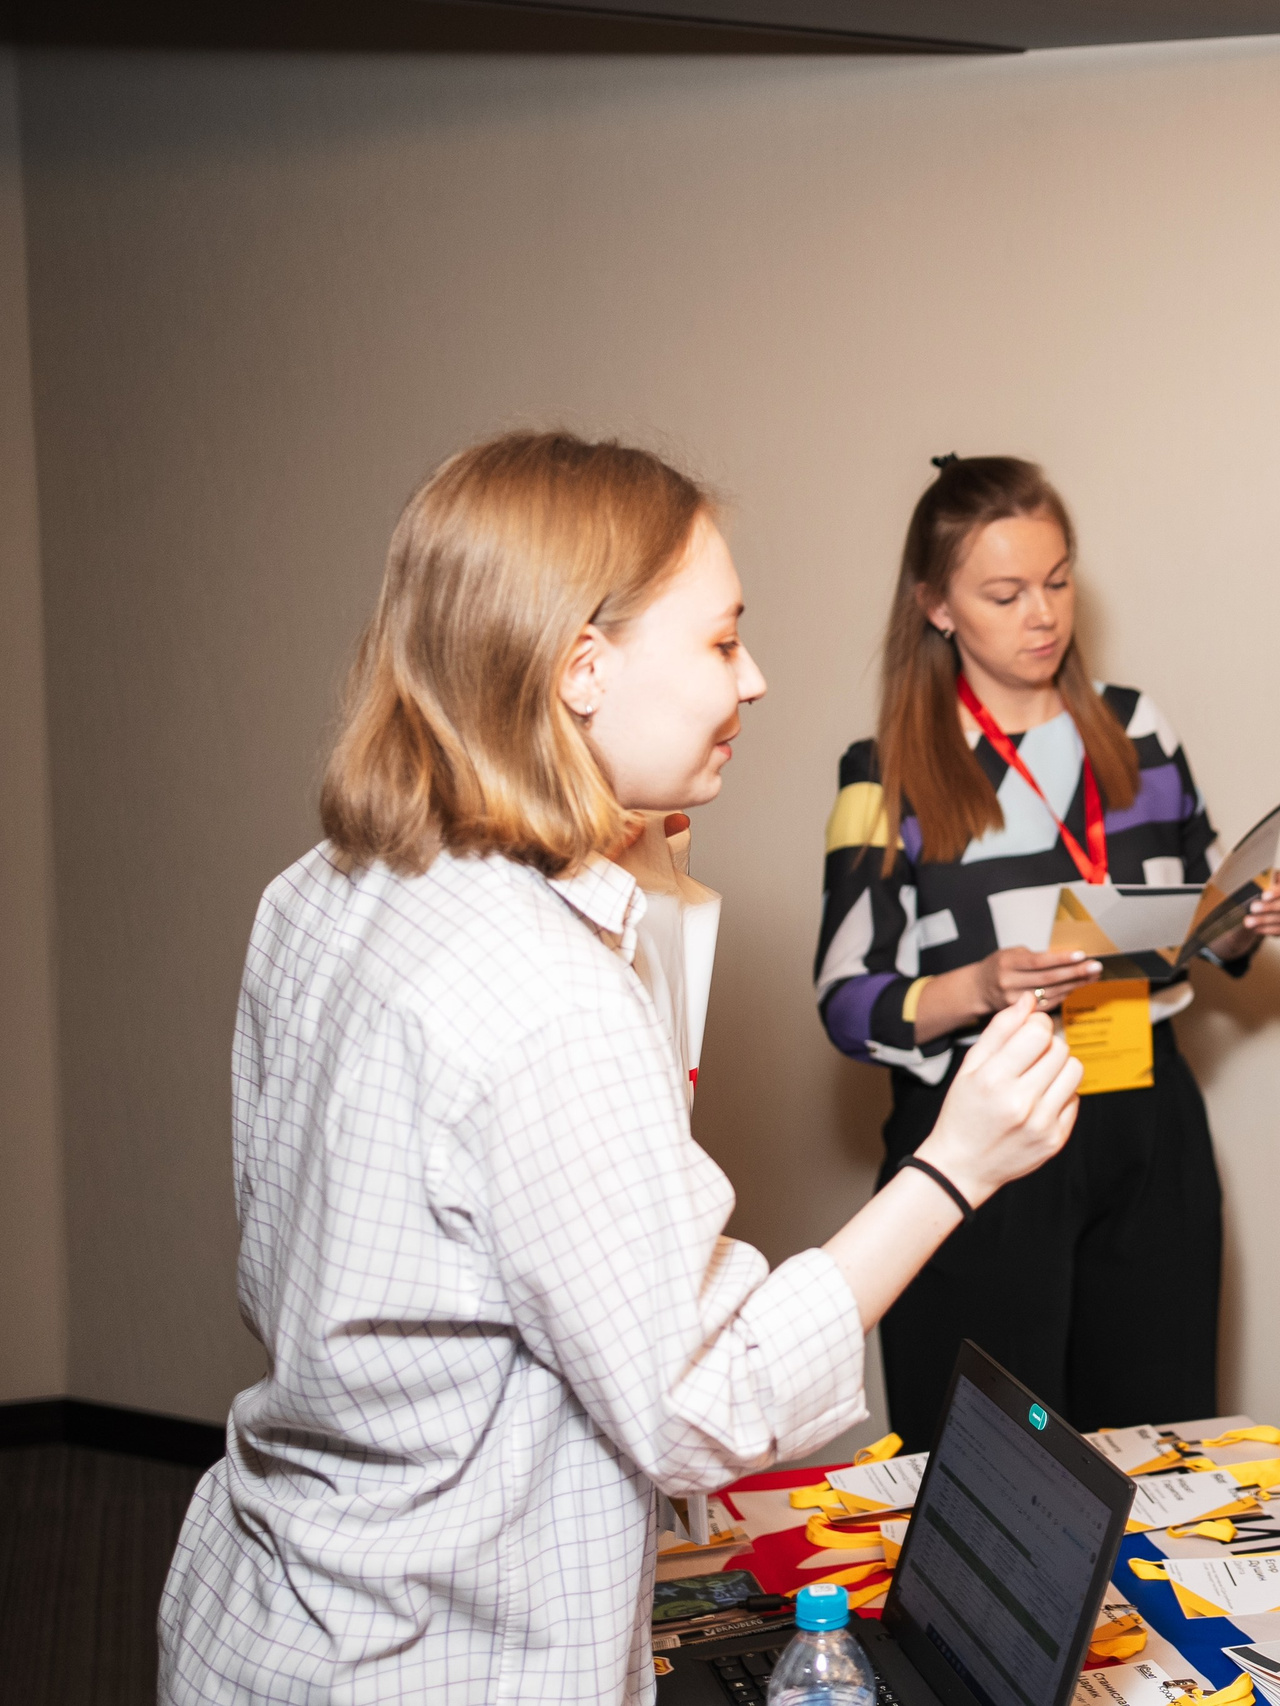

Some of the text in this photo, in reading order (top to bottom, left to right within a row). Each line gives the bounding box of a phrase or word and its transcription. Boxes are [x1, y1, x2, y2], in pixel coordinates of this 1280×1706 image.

[1247, 1558, 1267, 1581] Душин
[1264, 1558, 1279, 1574] Егор
[716, 1618, 764, 1634] BRAUBERG
